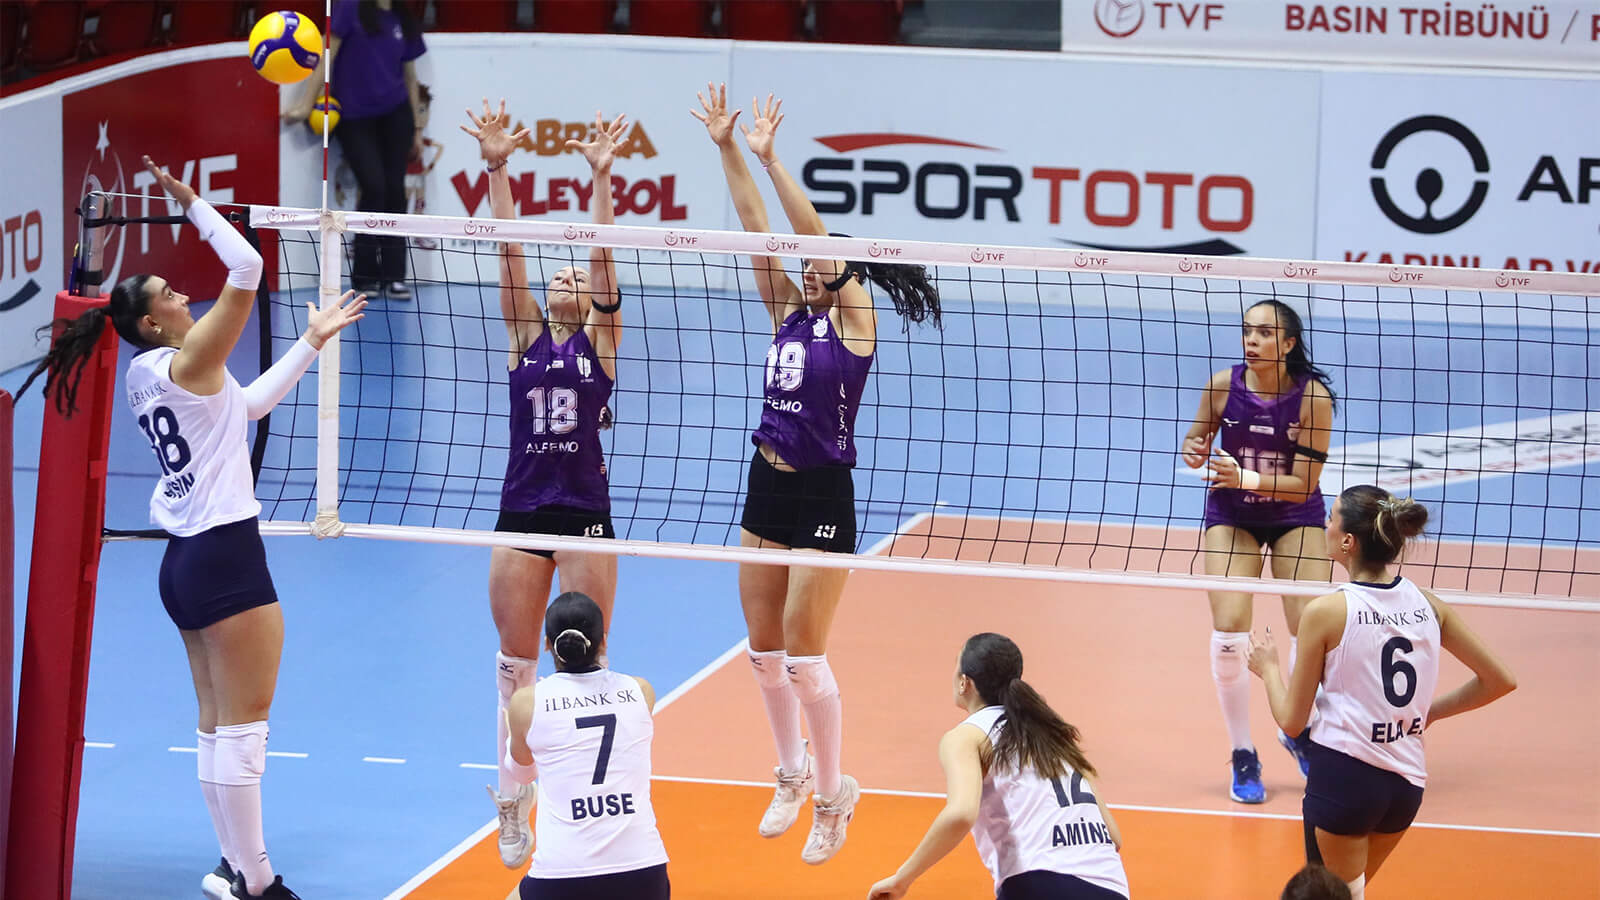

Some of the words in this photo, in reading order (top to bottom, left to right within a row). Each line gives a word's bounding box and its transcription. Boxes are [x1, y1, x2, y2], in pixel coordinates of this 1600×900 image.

[1154, 3, 1224, 31] TVF
[1285, 5, 1387, 34] BASIN
[1399, 2, 1549, 39] TRİBÜNÜ
[451, 169, 687, 221] VLEYBOL
[133, 154, 238, 255] TVF
[379, 219, 397, 227] TVF
[478, 225, 496, 233] TVF
[578, 231, 597, 240] TVF
[679, 236, 698, 245] TVF
[781, 242, 799, 251] TVF
[882, 247, 902, 257] TVF
[986, 253, 1005, 262] TVF
[1089, 257, 1109, 267] TVF
[1194, 262, 1213, 271] TVF
[1299, 267, 1318, 277] TVF
[1404, 272, 1424, 281] TVF
[1511, 278, 1530, 287] TVF
[527, 386, 578, 435] 18
[138, 405, 192, 476] 18
[1381, 636, 1417, 708] 6
[616, 689, 638, 704] SK
[1371, 720, 1404, 744] ELA
[575, 713, 617, 786] 7
[571, 793, 636, 821] BUSE
